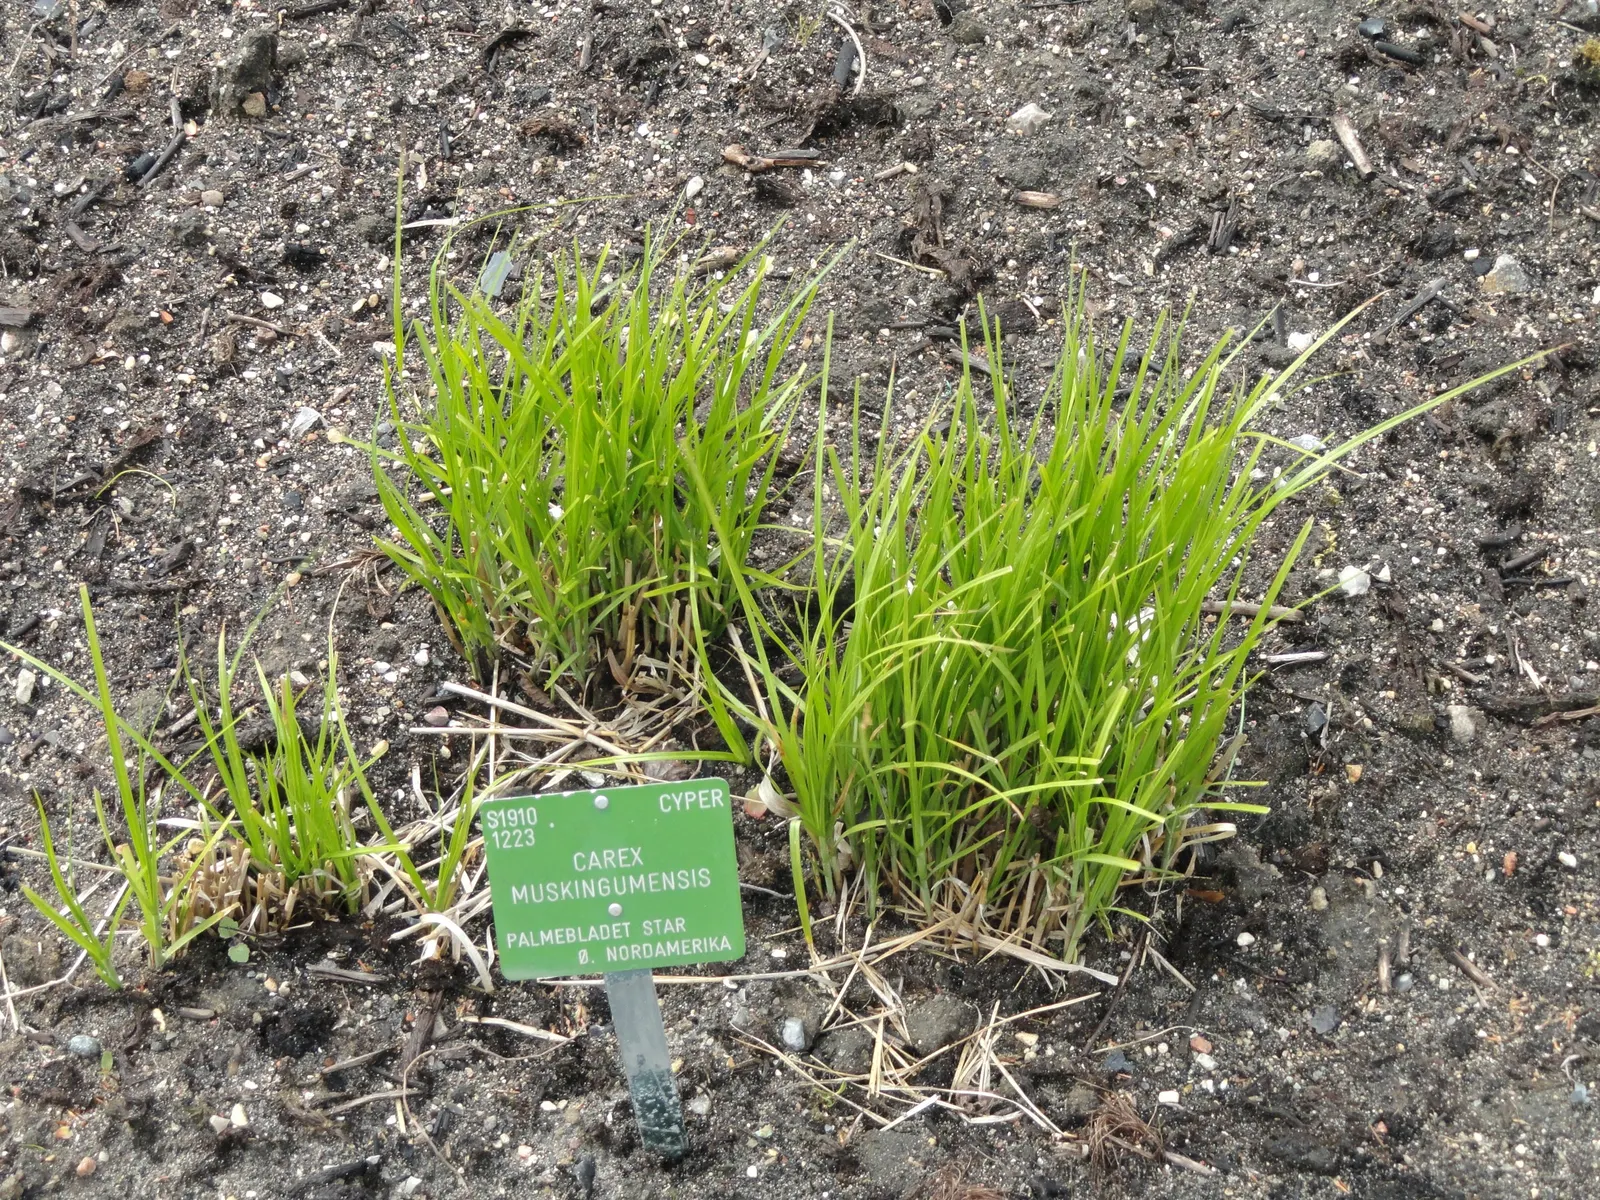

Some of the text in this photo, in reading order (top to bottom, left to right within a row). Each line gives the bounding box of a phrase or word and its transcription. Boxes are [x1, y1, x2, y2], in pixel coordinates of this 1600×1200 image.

[659, 789, 724, 813] CYPER
[487, 807, 538, 829] S1910
[492, 829, 536, 849] 1223
[573, 847, 644, 872] CAREX
[511, 868, 711, 905] MUSKINGUMENSIS
[507, 917, 686, 948] PALMEBLADET STAR
[607, 936, 732, 962] NORDAMERIKA
